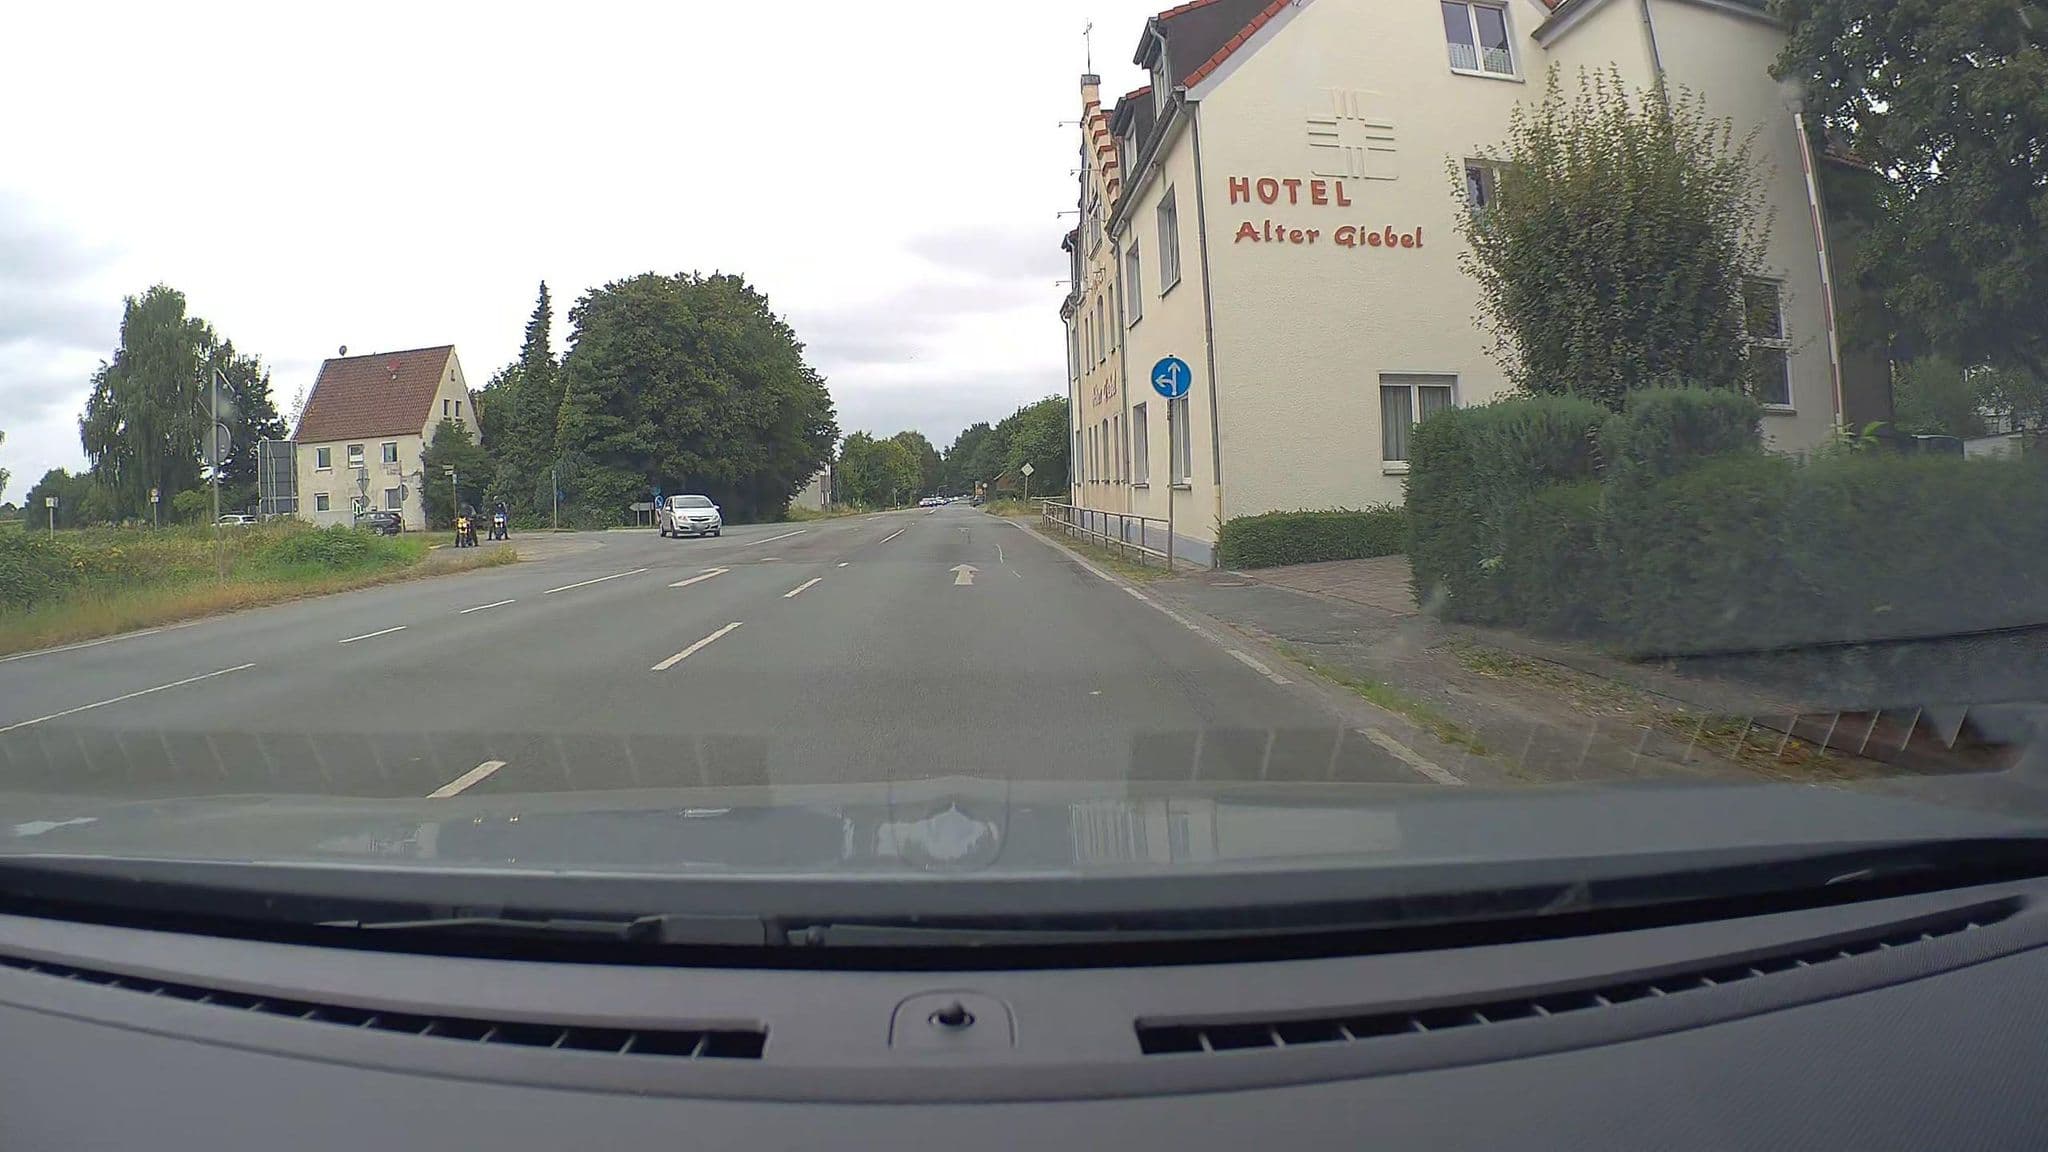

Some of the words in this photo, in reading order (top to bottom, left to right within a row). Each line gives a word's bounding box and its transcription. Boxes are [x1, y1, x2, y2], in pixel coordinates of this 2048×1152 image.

[1229, 177, 1351, 206] HOTEL
[1235, 220, 1319, 244] Alter
[1334, 225, 1423, 248] Giebel
